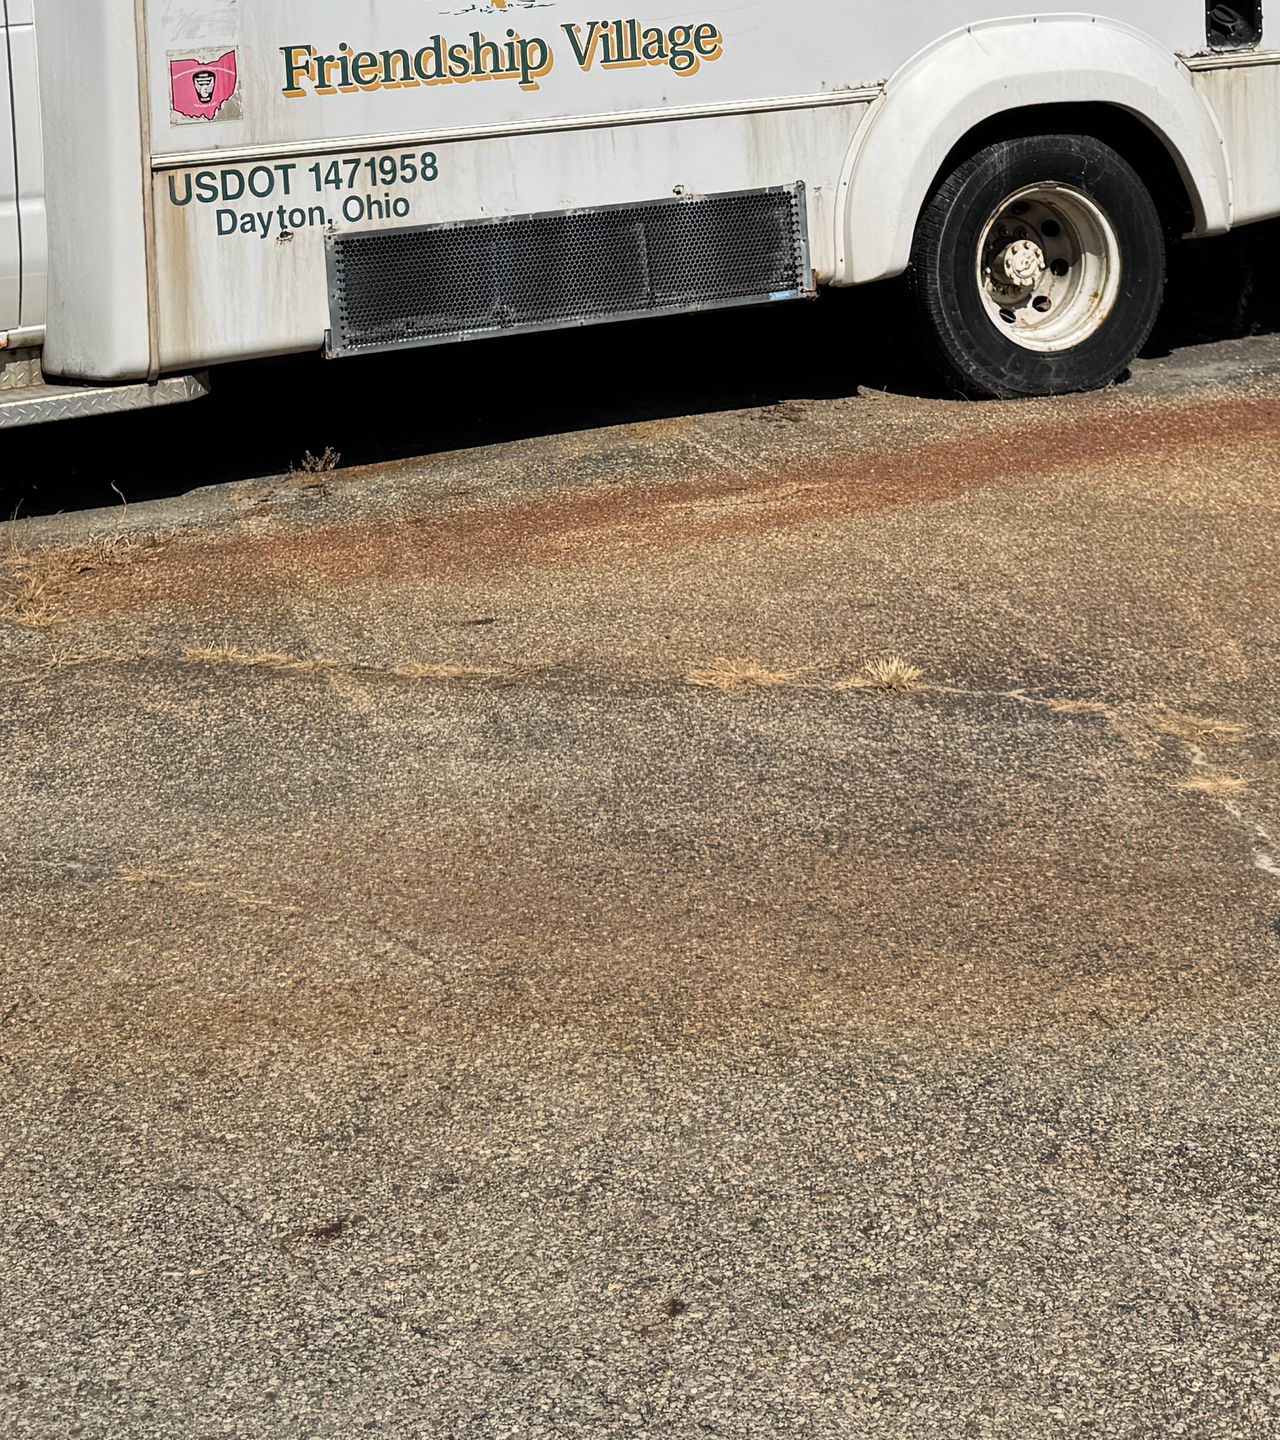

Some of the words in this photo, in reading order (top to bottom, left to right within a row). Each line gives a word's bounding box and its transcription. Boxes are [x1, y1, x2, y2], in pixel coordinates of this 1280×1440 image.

[279, 25, 553, 97] Friendship
[561, 19, 724, 77] Village
[168, 163, 297, 206] USDOT
[308, 152, 439, 192] 1471958
[216, 205, 334, 237] Dayton,
[342, 193, 410, 224] Ohio
